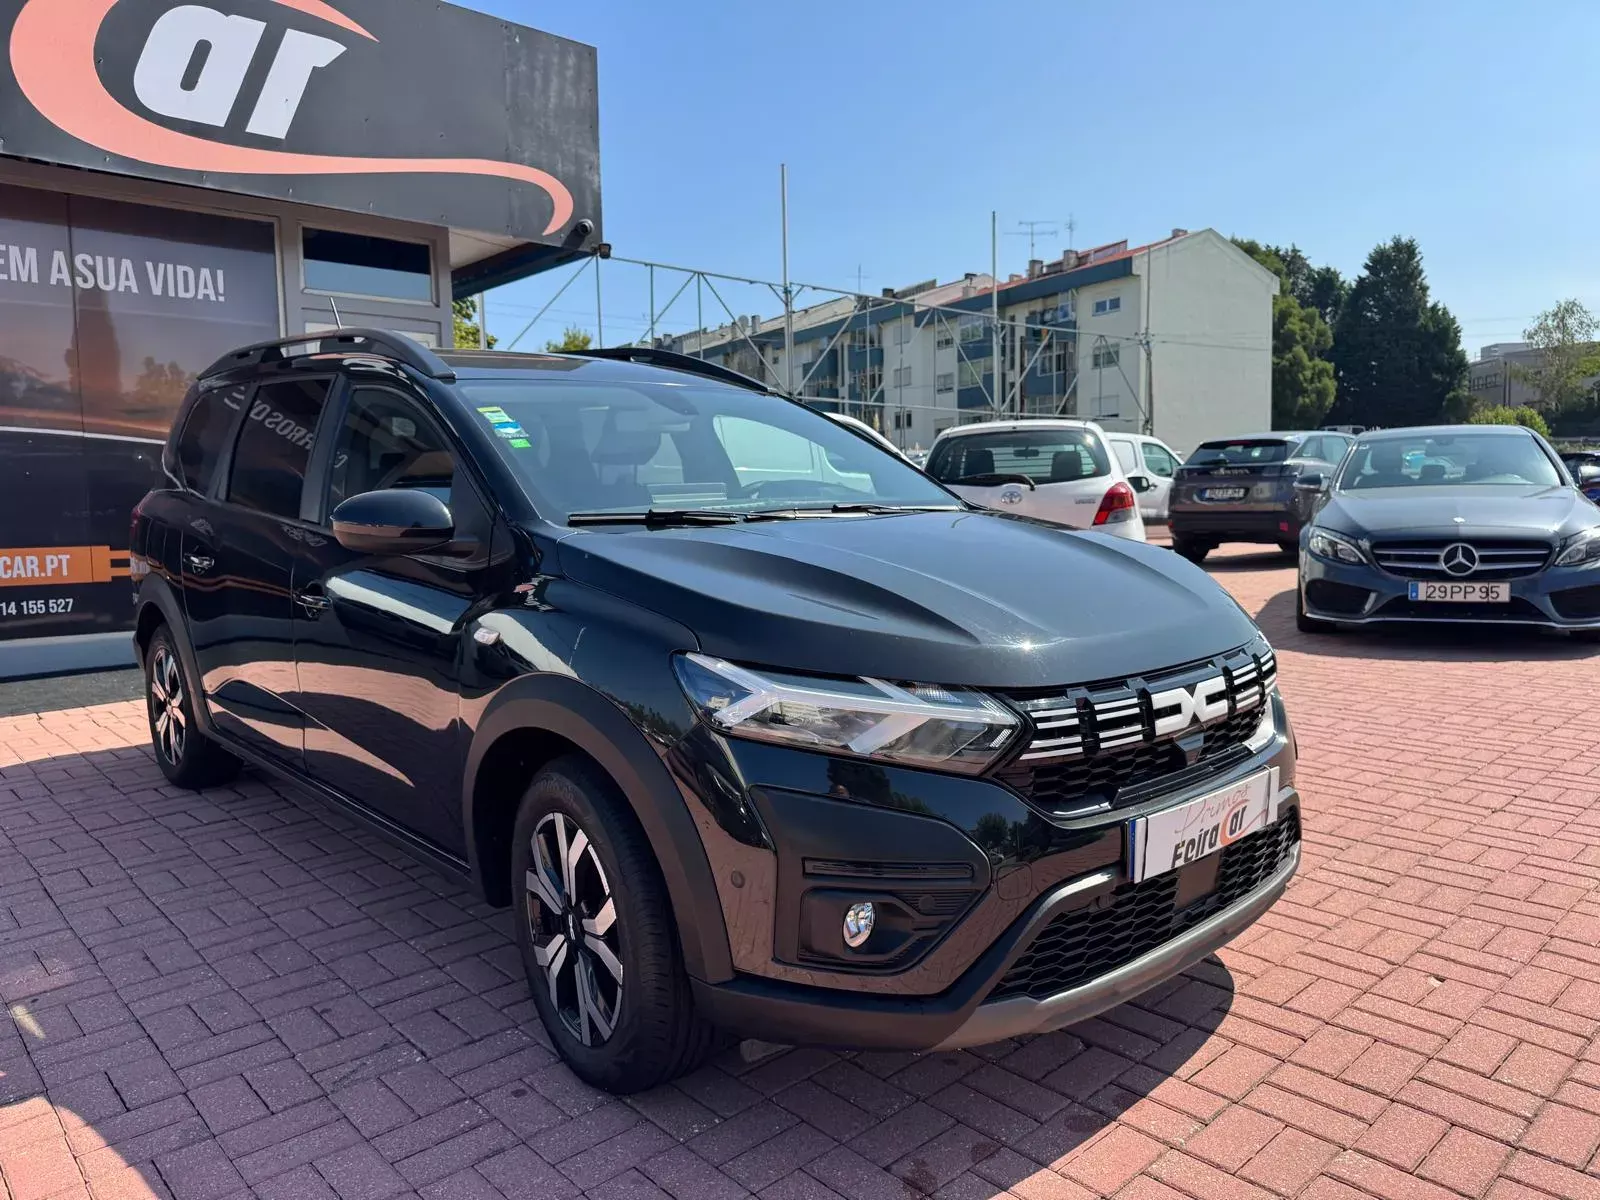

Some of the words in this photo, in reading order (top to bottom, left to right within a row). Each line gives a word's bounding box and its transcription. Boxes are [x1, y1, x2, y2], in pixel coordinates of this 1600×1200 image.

[145, 261, 225, 302] VIDA!
[0, 554, 70, 579] CAR.PT
[20, 599, 46, 615] 155
[48, 597, 74, 613] 527
